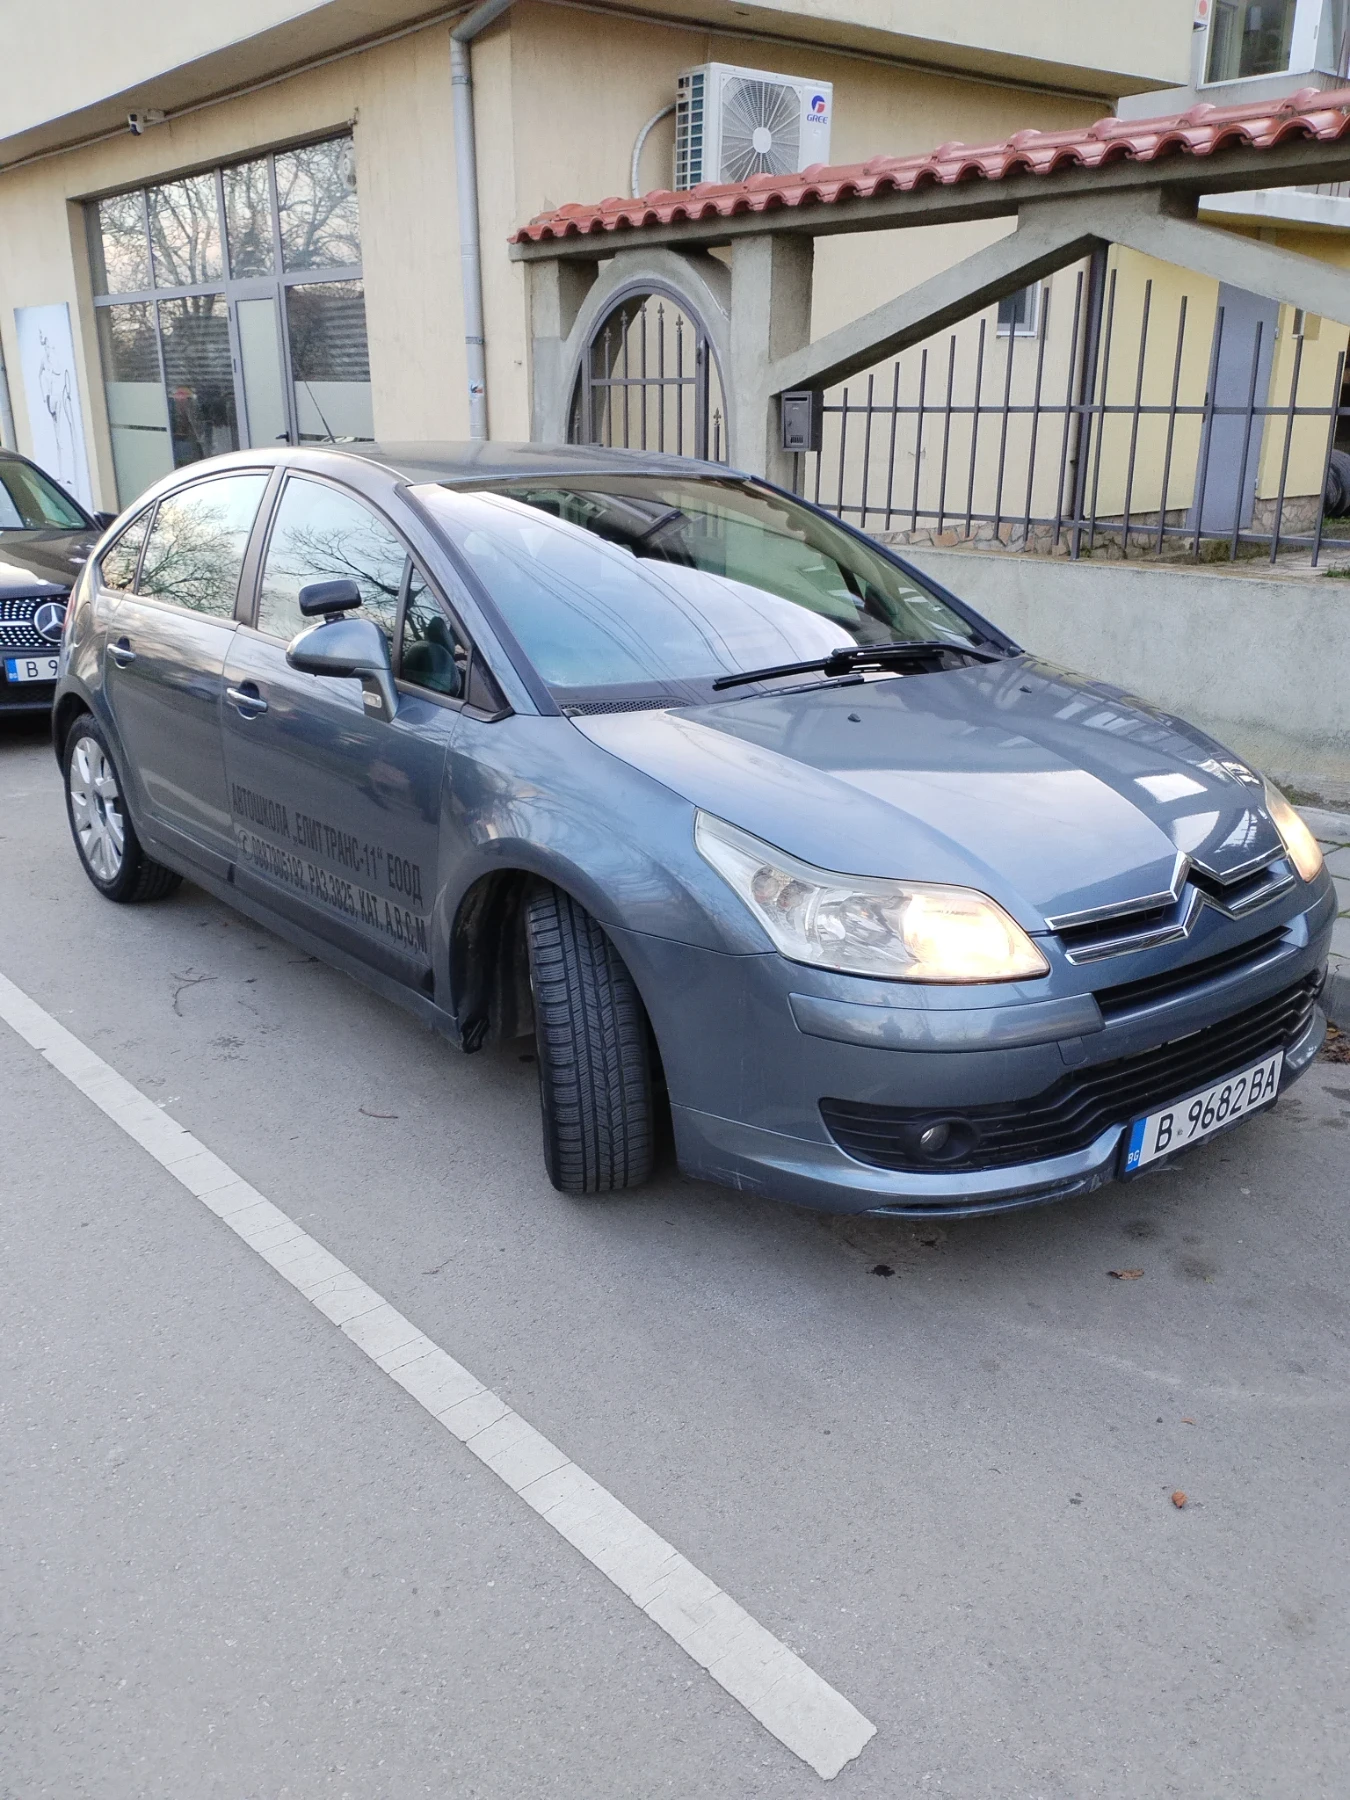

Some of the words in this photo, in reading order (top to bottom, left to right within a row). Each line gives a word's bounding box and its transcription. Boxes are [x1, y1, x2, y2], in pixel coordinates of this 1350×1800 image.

[806, 113, 828, 125] GREE
[26, 661, 39, 678] B
[386, 852, 424, 909] ЕООД
[1154, 1113, 1175, 1155] B
[1127, 1150, 1140, 1165] BG
